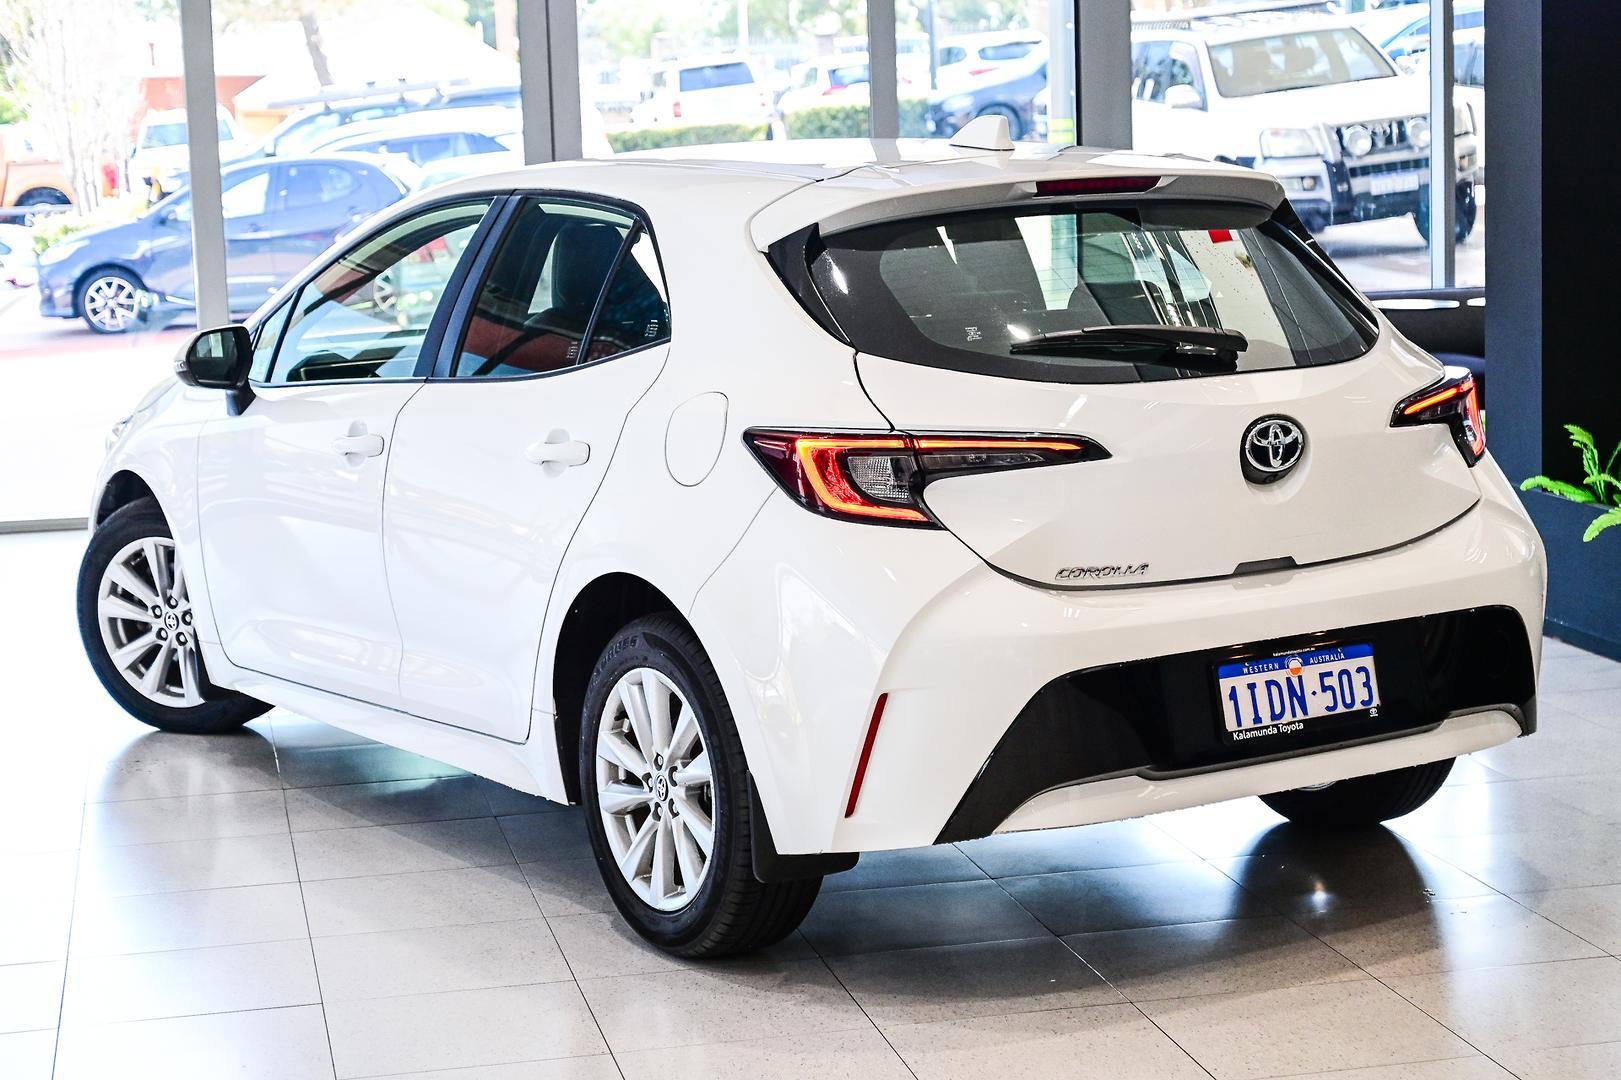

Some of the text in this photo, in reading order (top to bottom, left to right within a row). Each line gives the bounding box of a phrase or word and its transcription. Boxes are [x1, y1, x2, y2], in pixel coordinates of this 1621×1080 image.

[1055, 563, 1149, 581] COROLLA
[1243, 652, 1345, 674] WESTERN AUSTRALIA
[1233, 722, 1304, 741] Kalamunda Toyota
